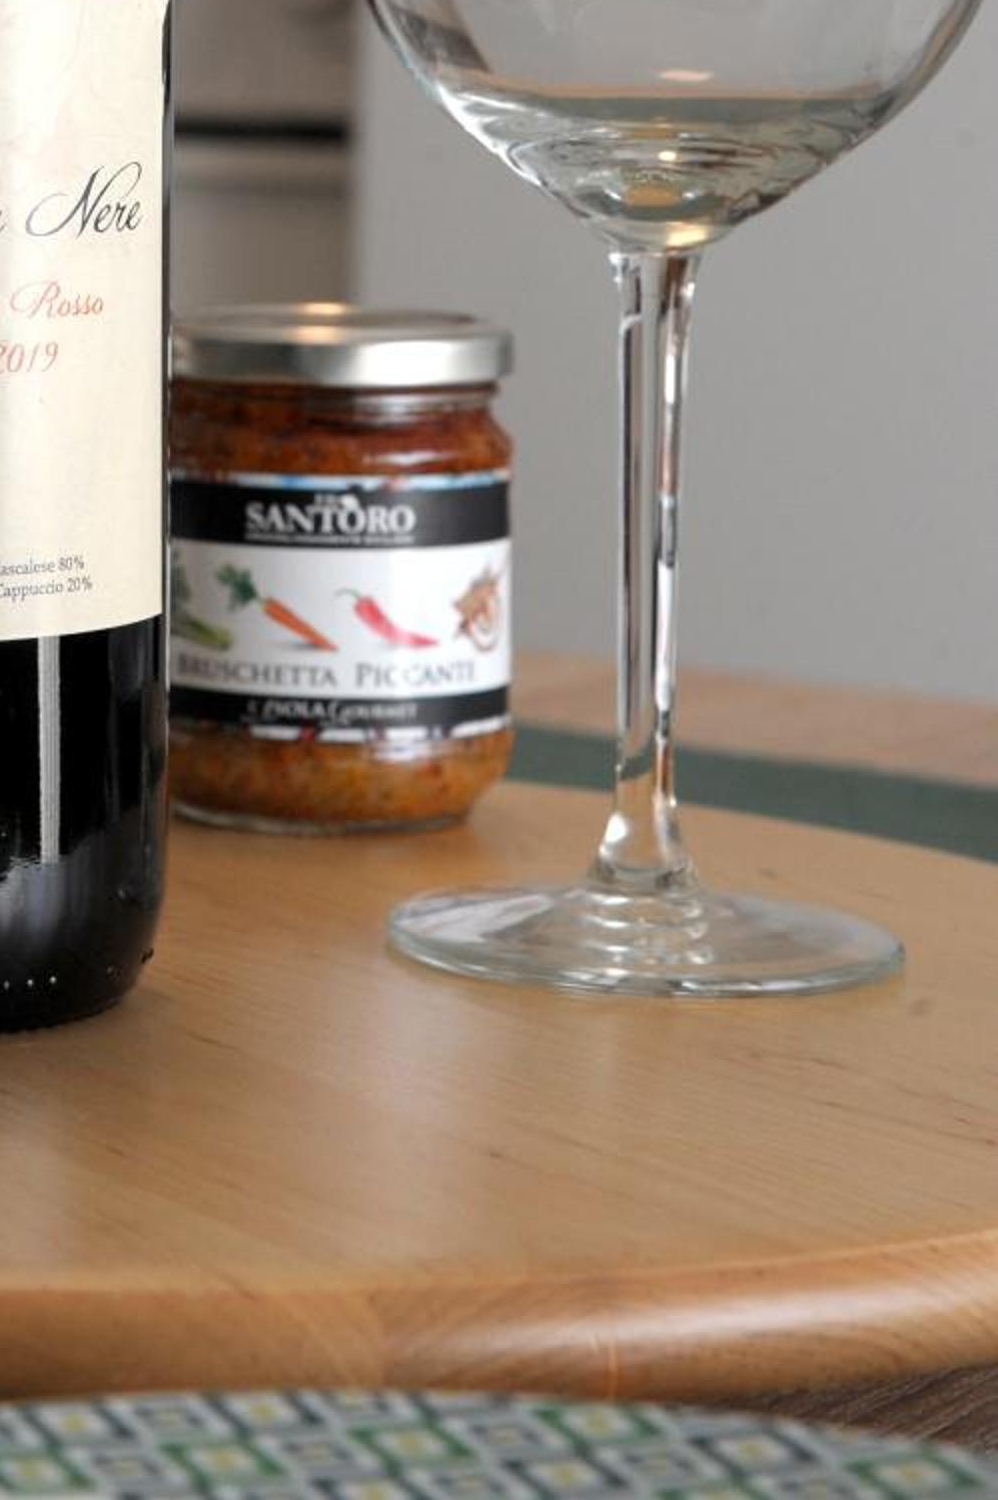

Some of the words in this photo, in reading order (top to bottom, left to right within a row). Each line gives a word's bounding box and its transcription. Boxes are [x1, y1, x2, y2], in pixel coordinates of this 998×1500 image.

[25, 160, 142, 239] Nere
[8, 280, 105, 320] Rosso
[245, 503, 417, 534] SANTORO
[66, 575, 93, 594] 20%
